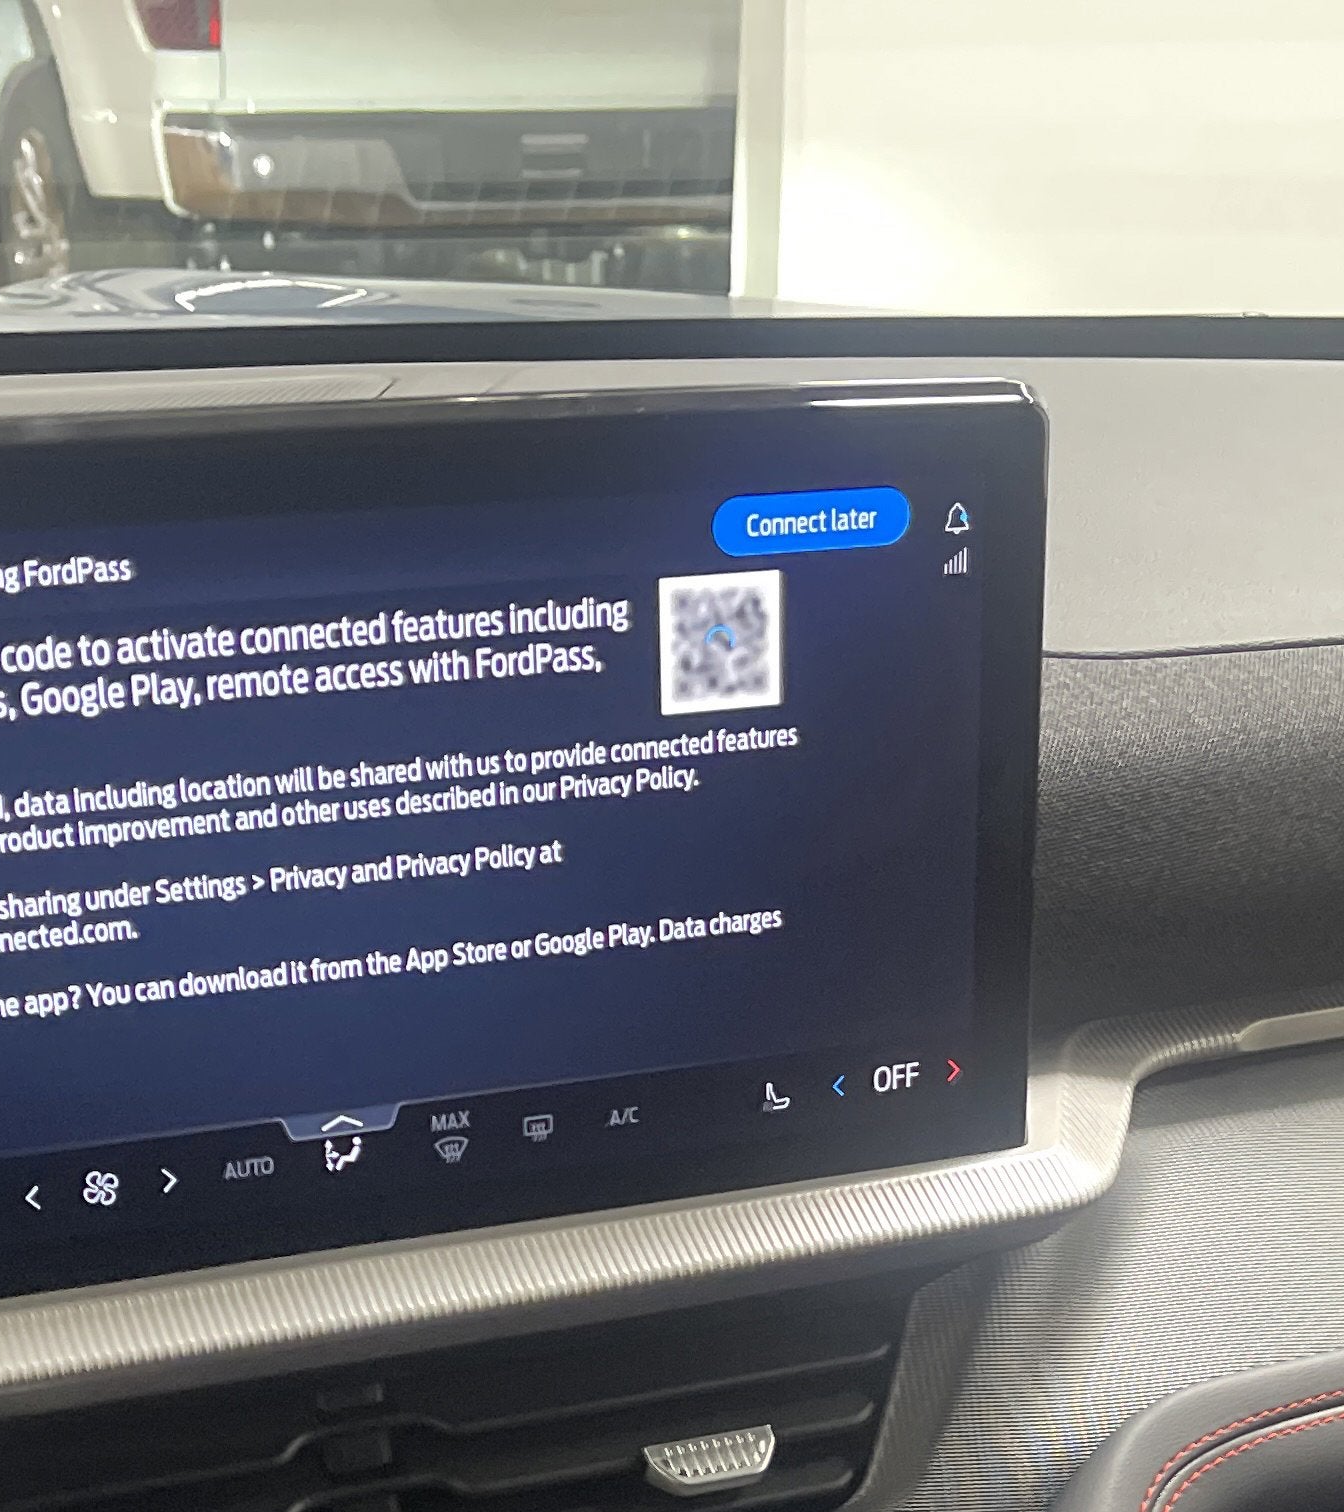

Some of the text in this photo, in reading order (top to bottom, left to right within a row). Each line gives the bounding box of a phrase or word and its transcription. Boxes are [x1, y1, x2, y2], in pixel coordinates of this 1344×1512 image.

[746, 507, 878, 537] Connect later
[23, 556, 132, 588] FordPass
[0, 635, 73, 674] code
[76, 634, 112, 667] to
[116, 625, 236, 665] activate
[240, 611, 388, 656] connected
[390, 608, 505, 644] features
[508, 596, 630, 635] including
[20, 676, 126, 718] Google
[130, 672, 202, 710] Play,
[206, 663, 310, 701] remote
[314, 660, 405, 693] access
[407, 648, 471, 684] with
[475, 642, 602, 679] FordPass,
[14, 790, 72, 818] data
[72, 780, 178, 814] including
[178, 772, 272, 804] location
[274, 765, 315, 795] will
[317, 764, 346, 791] be
[349, 756, 423, 788] shared
[424, 752, 474, 781] with
[476, 755, 502, 776] us
[503, 749, 528, 774] to
[530, 740, 607, 776] provide
[610, 729, 714, 763] connected
[716, 727, 798, 753] features
[77, 808, 232, 848] improvement
[234, 801, 278, 831] and
[281, 798, 341, 826] other
[343, 796, 392, 821] uses
[395, 781, 496, 816] described
[498, 780, 520, 806] in
[522, 781, 558, 803] our
[560, 773, 633, 800] Privacy
[635, 764, 700, 792] Policy.
[84, 881, 152, 912] under
[154, 874, 248, 904] Settings
[269, 864, 348, 892] Privacy
[351, 855, 394, 884] and
[396, 852, 471, 880] Privacy
[474, 843, 536, 871] Policy
[539, 839, 563, 864] at
[24, 984, 82, 1018] app?
[84, 982, 132, 1008] You
[134, 979, 176, 1002] can
[178, 960, 288, 998] download
[289, 960, 308, 985] it
[309, 957, 364, 982] from
[365, 950, 403, 976] the
[405, 946, 449, 974] App
[452, 941, 508, 966] Store
[510, 938, 533, 959] or
[534, 926, 605, 956] Google
[608, 922, 656, 948] Play.
[658, 916, 707, 942] Data
[709, 910, 783, 936] charges
[873, 1061, 920, 1093] OFF
[430, 1111, 471, 1132] MAX
[609, 1106, 640, 1127] A/C
[223, 1155, 275, 1181] AUTO
